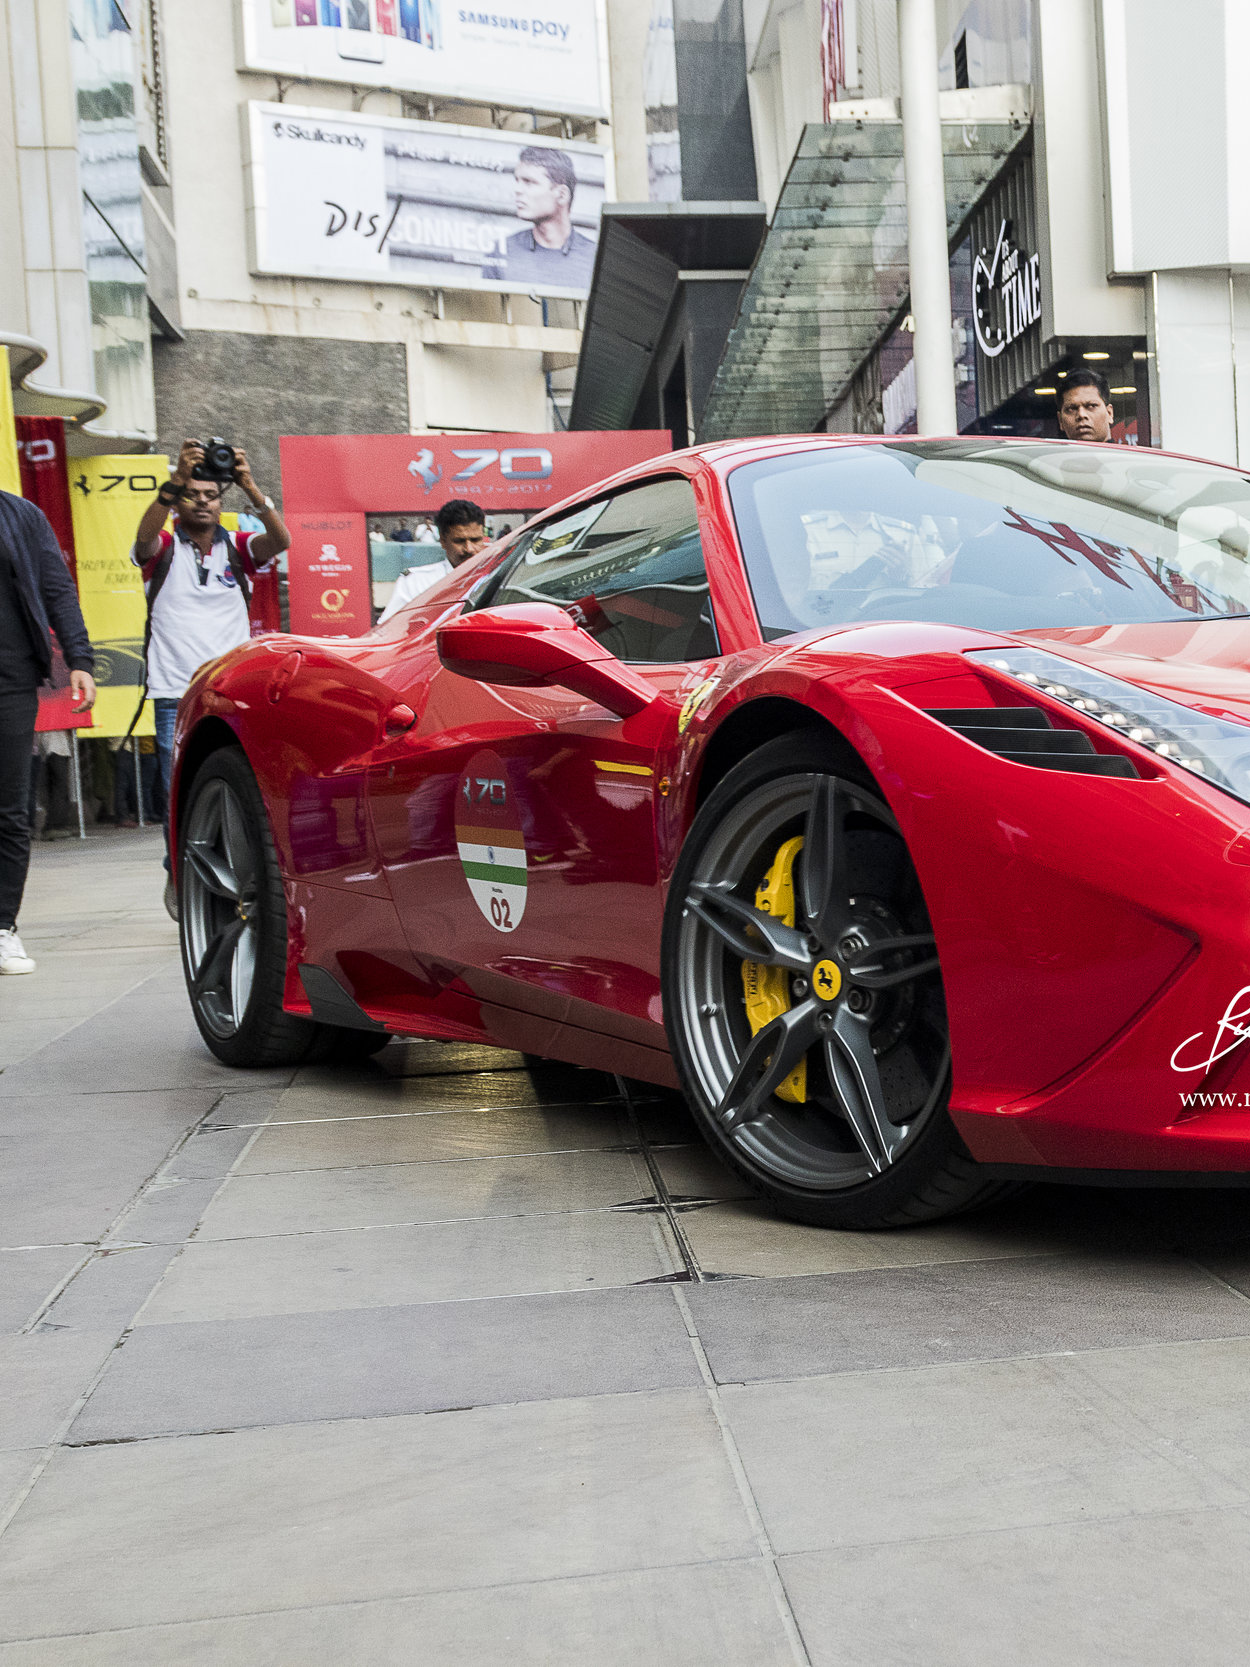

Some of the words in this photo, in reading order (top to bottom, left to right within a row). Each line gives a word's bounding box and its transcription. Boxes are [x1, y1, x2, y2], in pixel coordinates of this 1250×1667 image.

[459, 9, 528, 31] SAMSUNG
[532, 19, 569, 41] pay
[287, 125, 366, 150] Skullcandy
[1002, 252, 1041, 344] TIME
[451, 448, 553, 481] 70
[98, 475, 157, 491] 70
[475, 778, 506, 805] 70
[491, 896, 513, 929] 02
